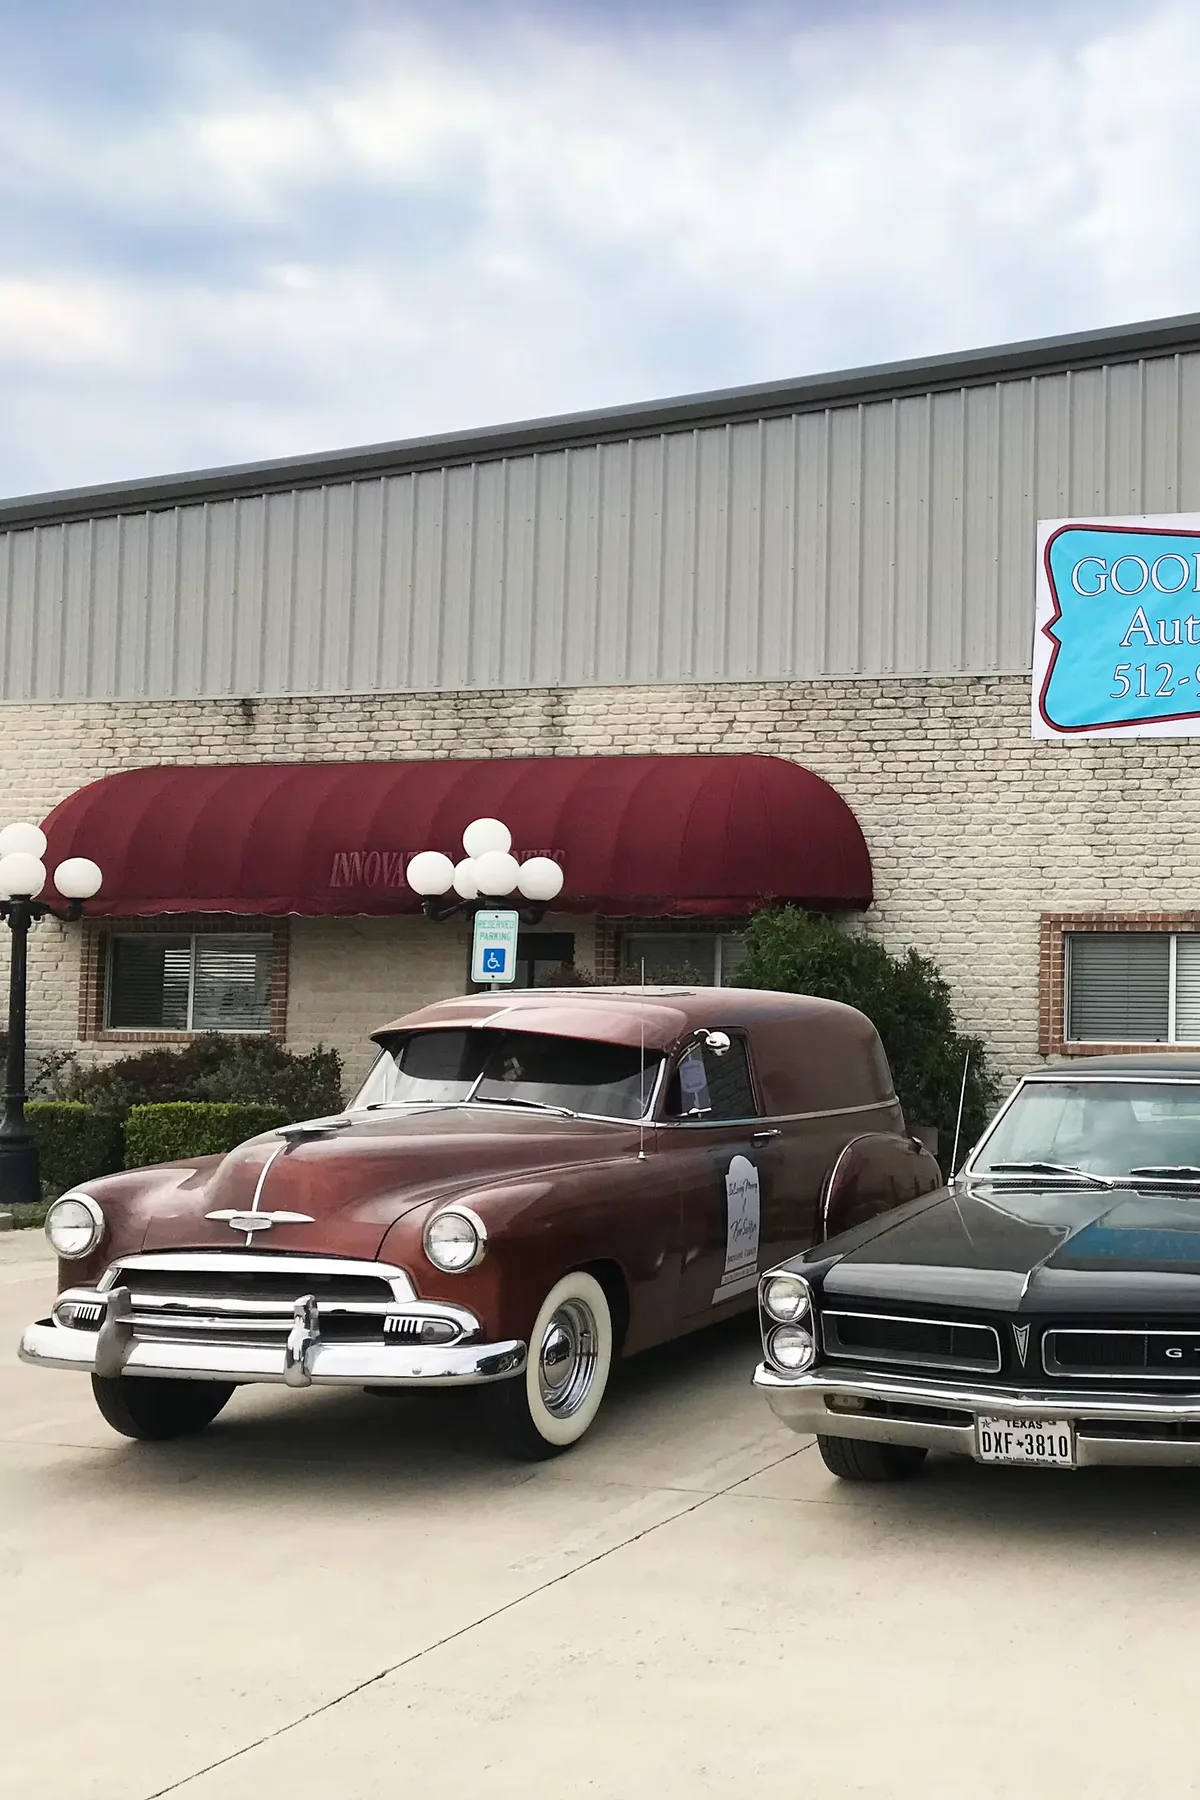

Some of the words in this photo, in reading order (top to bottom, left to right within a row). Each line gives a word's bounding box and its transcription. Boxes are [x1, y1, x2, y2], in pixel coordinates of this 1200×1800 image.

[328, 851, 453, 887] INNOVA
[477, 920, 515, 929] RESERVED
[480, 932, 512, 941] PARKING
[1006, 1419, 1043, 1429] TEXAS
[982, 1431, 1013, 1454] DXF
[1024, 1433, 1068, 1457] 3810
